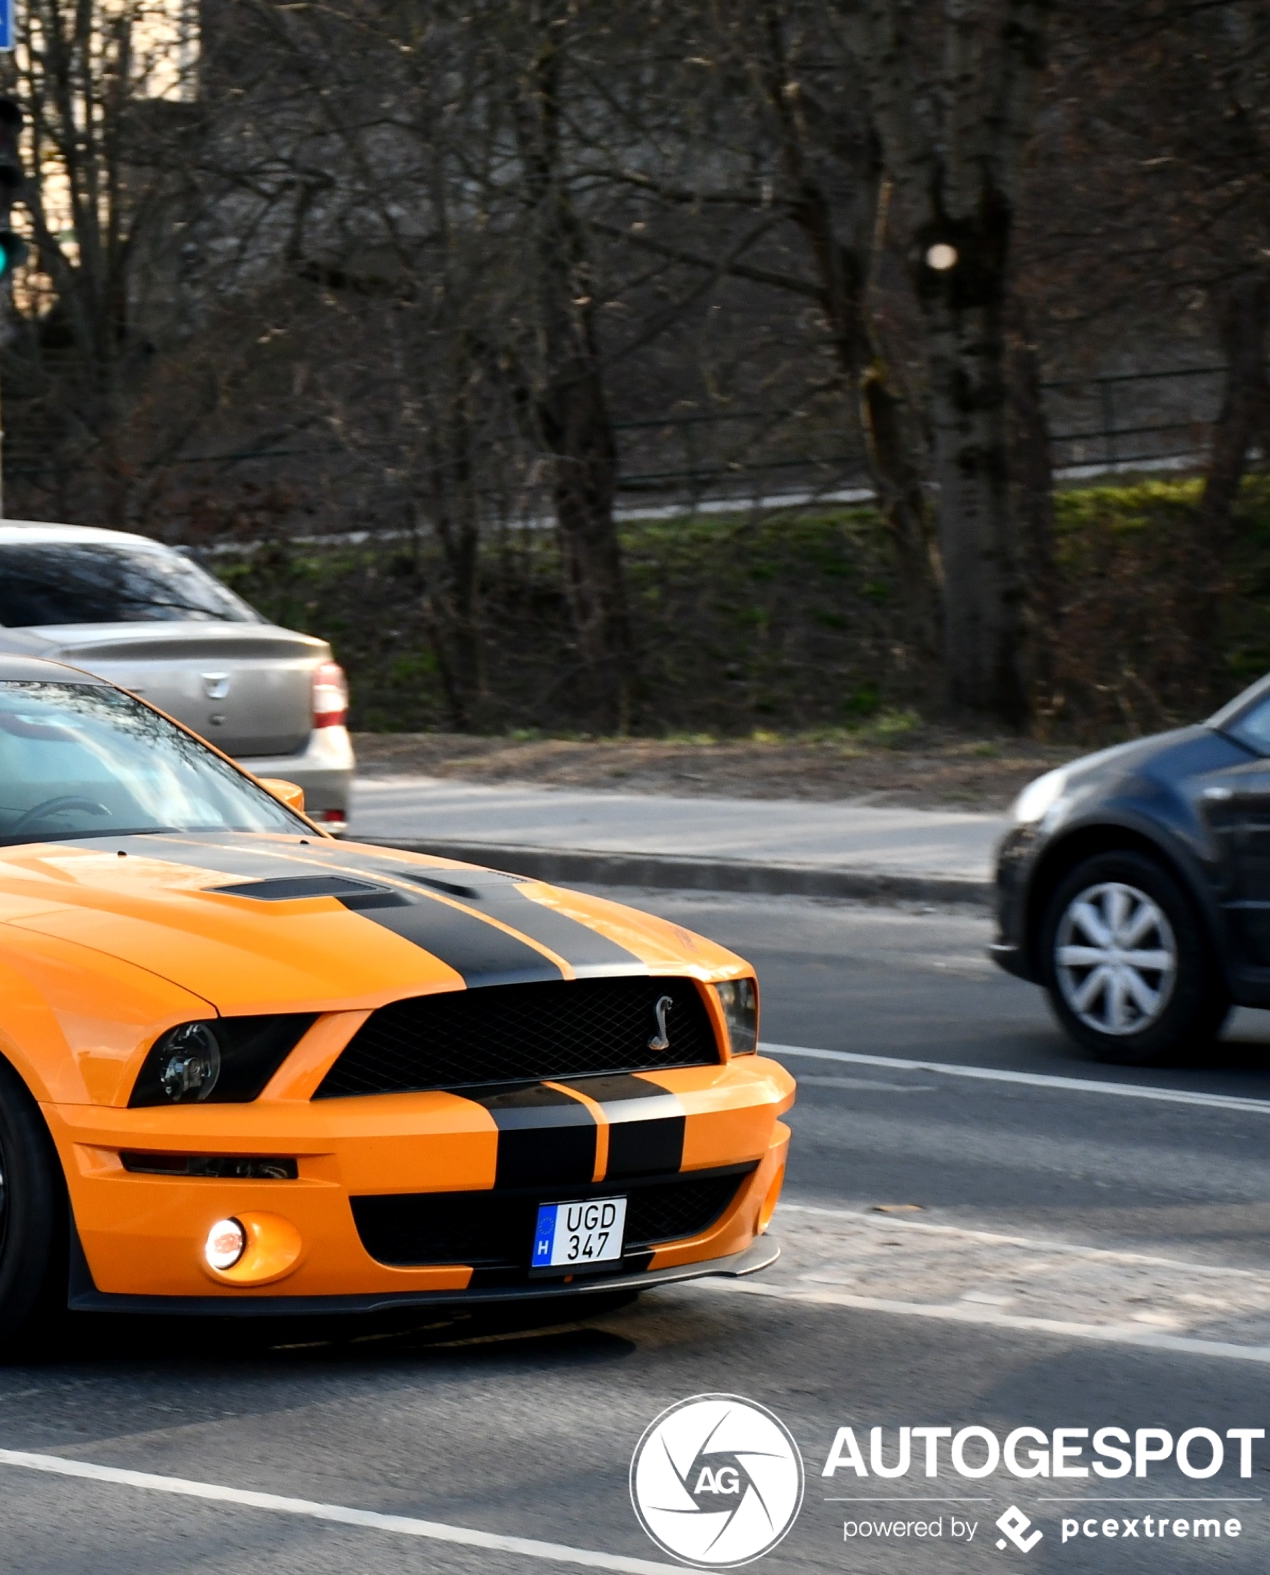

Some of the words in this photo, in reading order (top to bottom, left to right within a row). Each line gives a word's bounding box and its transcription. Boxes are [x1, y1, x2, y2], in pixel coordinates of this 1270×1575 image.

[567, 1203, 616, 1232] UGD
[537, 1240, 549, 1255] H
[567, 1232, 610, 1260] 347
